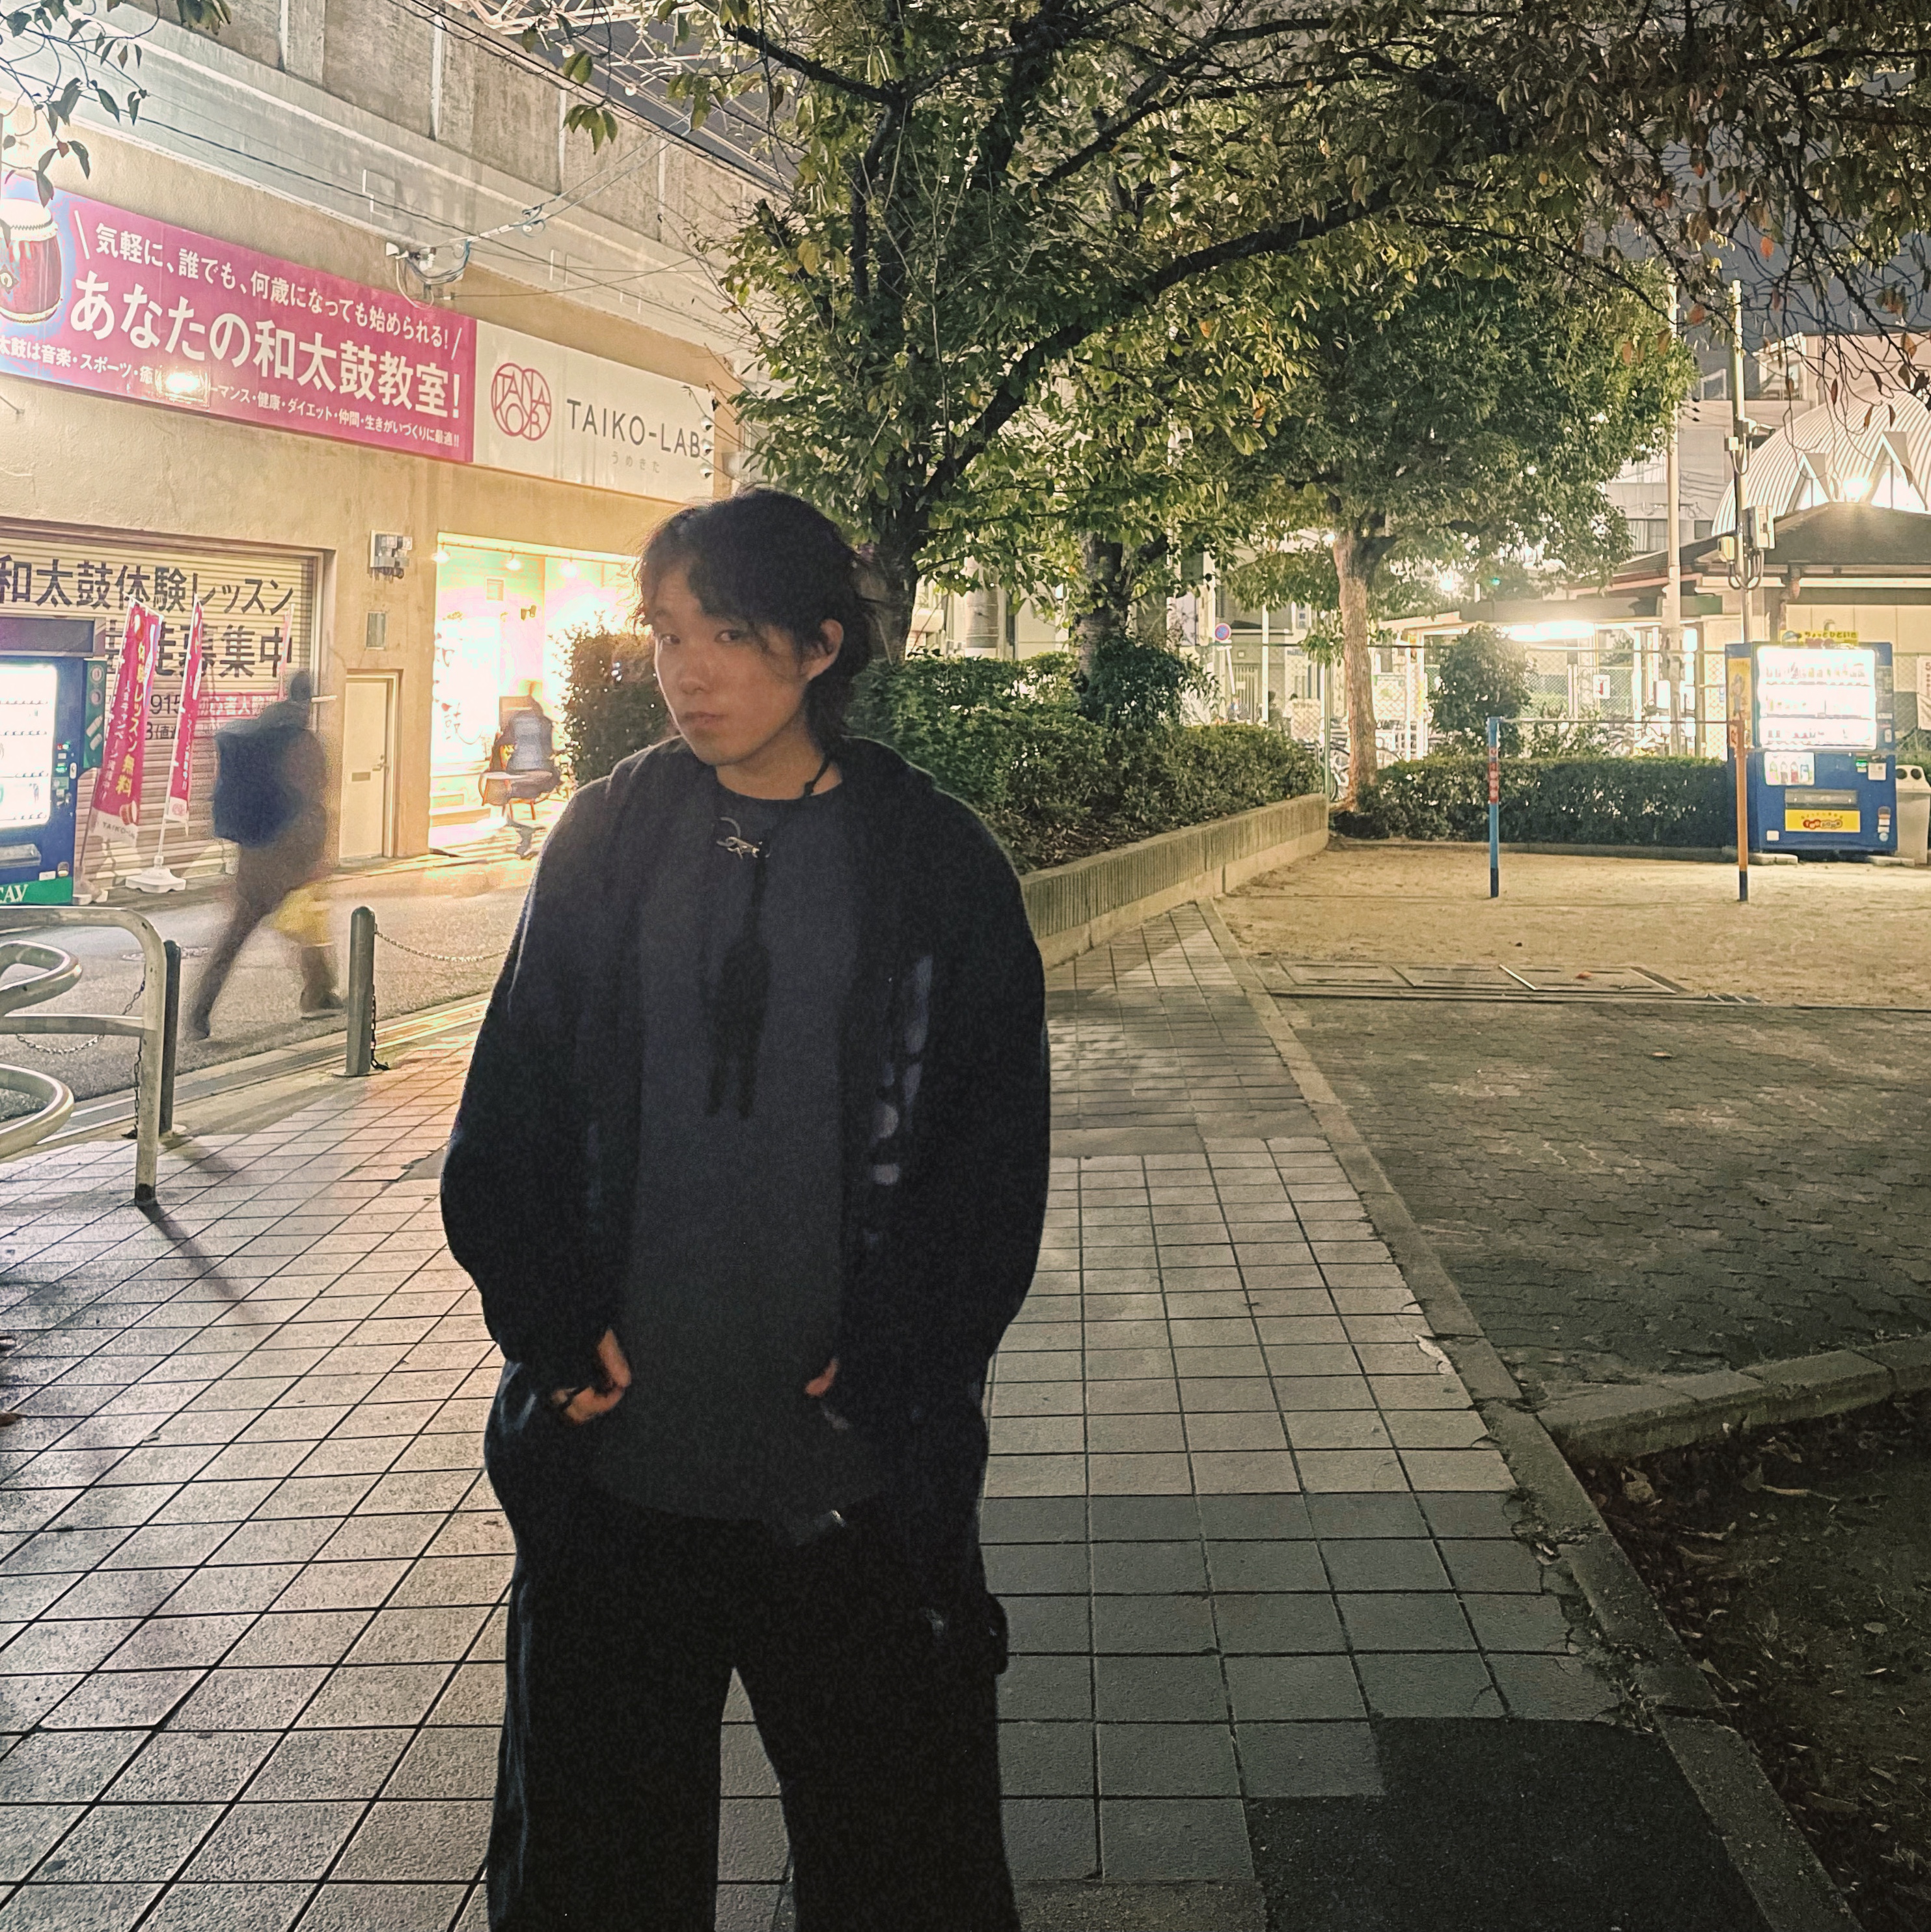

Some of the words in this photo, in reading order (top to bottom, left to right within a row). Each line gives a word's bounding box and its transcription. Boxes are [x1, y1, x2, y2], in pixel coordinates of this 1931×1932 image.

[70, 270, 460, 419] あなたの和太鼓教室!
[567, 398, 701, 458] TAIKO-LAB
[611, 451, 660, 474] うめきた
[0, 555, 294, 615] 和太鼓体験レッスン
